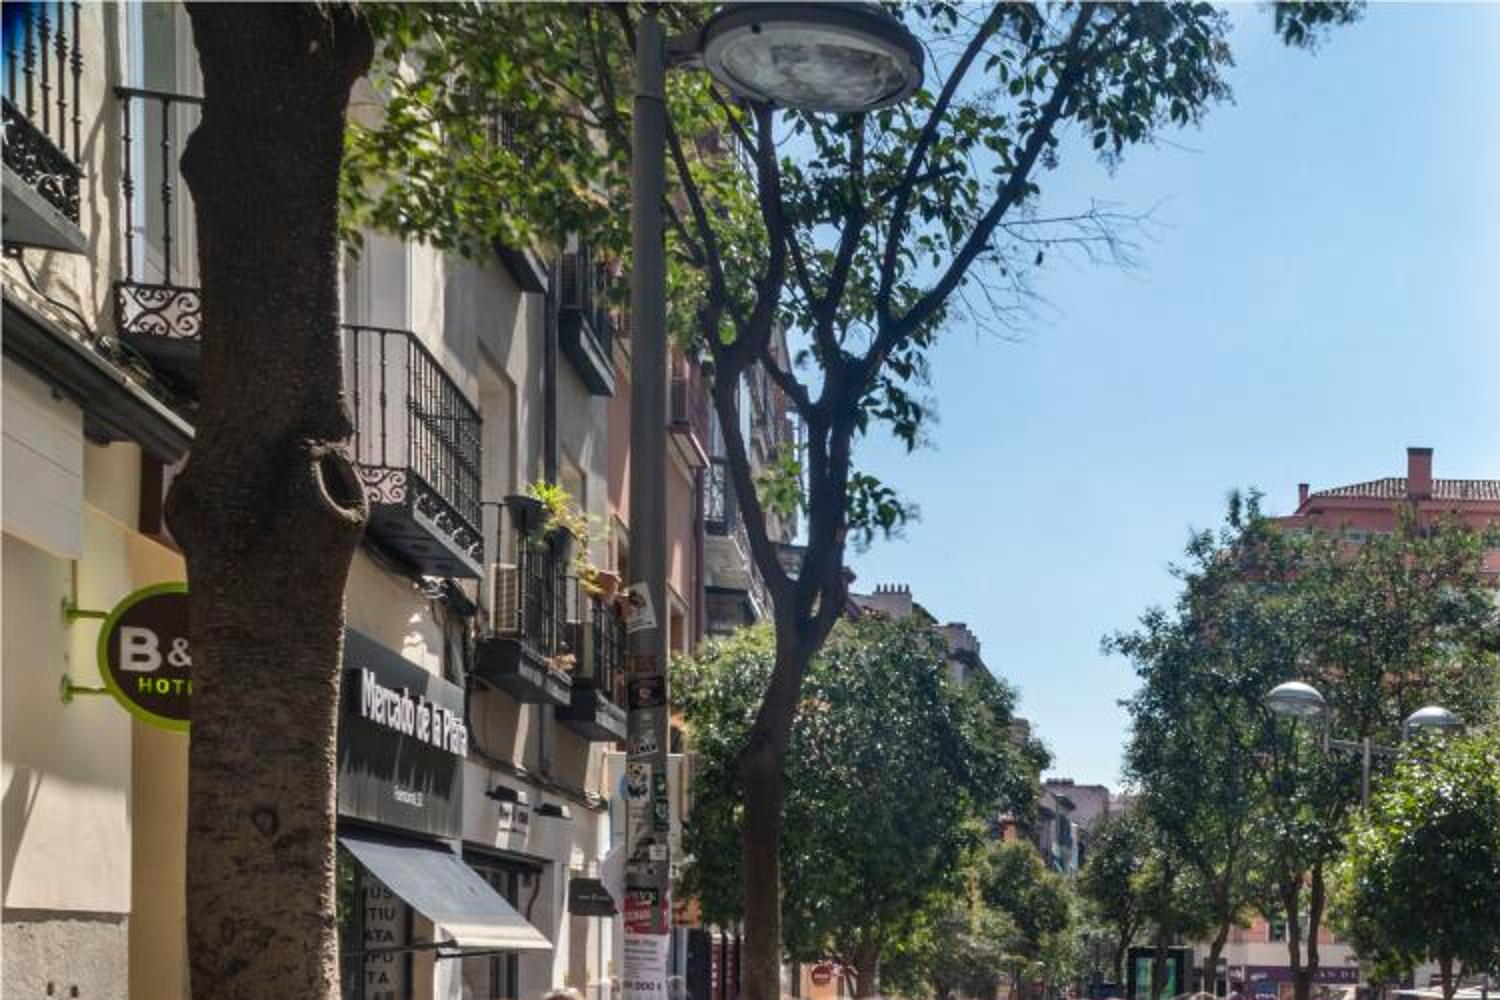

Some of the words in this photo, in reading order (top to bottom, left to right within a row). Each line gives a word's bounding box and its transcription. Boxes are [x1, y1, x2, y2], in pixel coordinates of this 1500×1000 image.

[361, 667, 415, 737] Mercado
[416, 695, 431, 744] de
[432, 702, 442, 748] la
